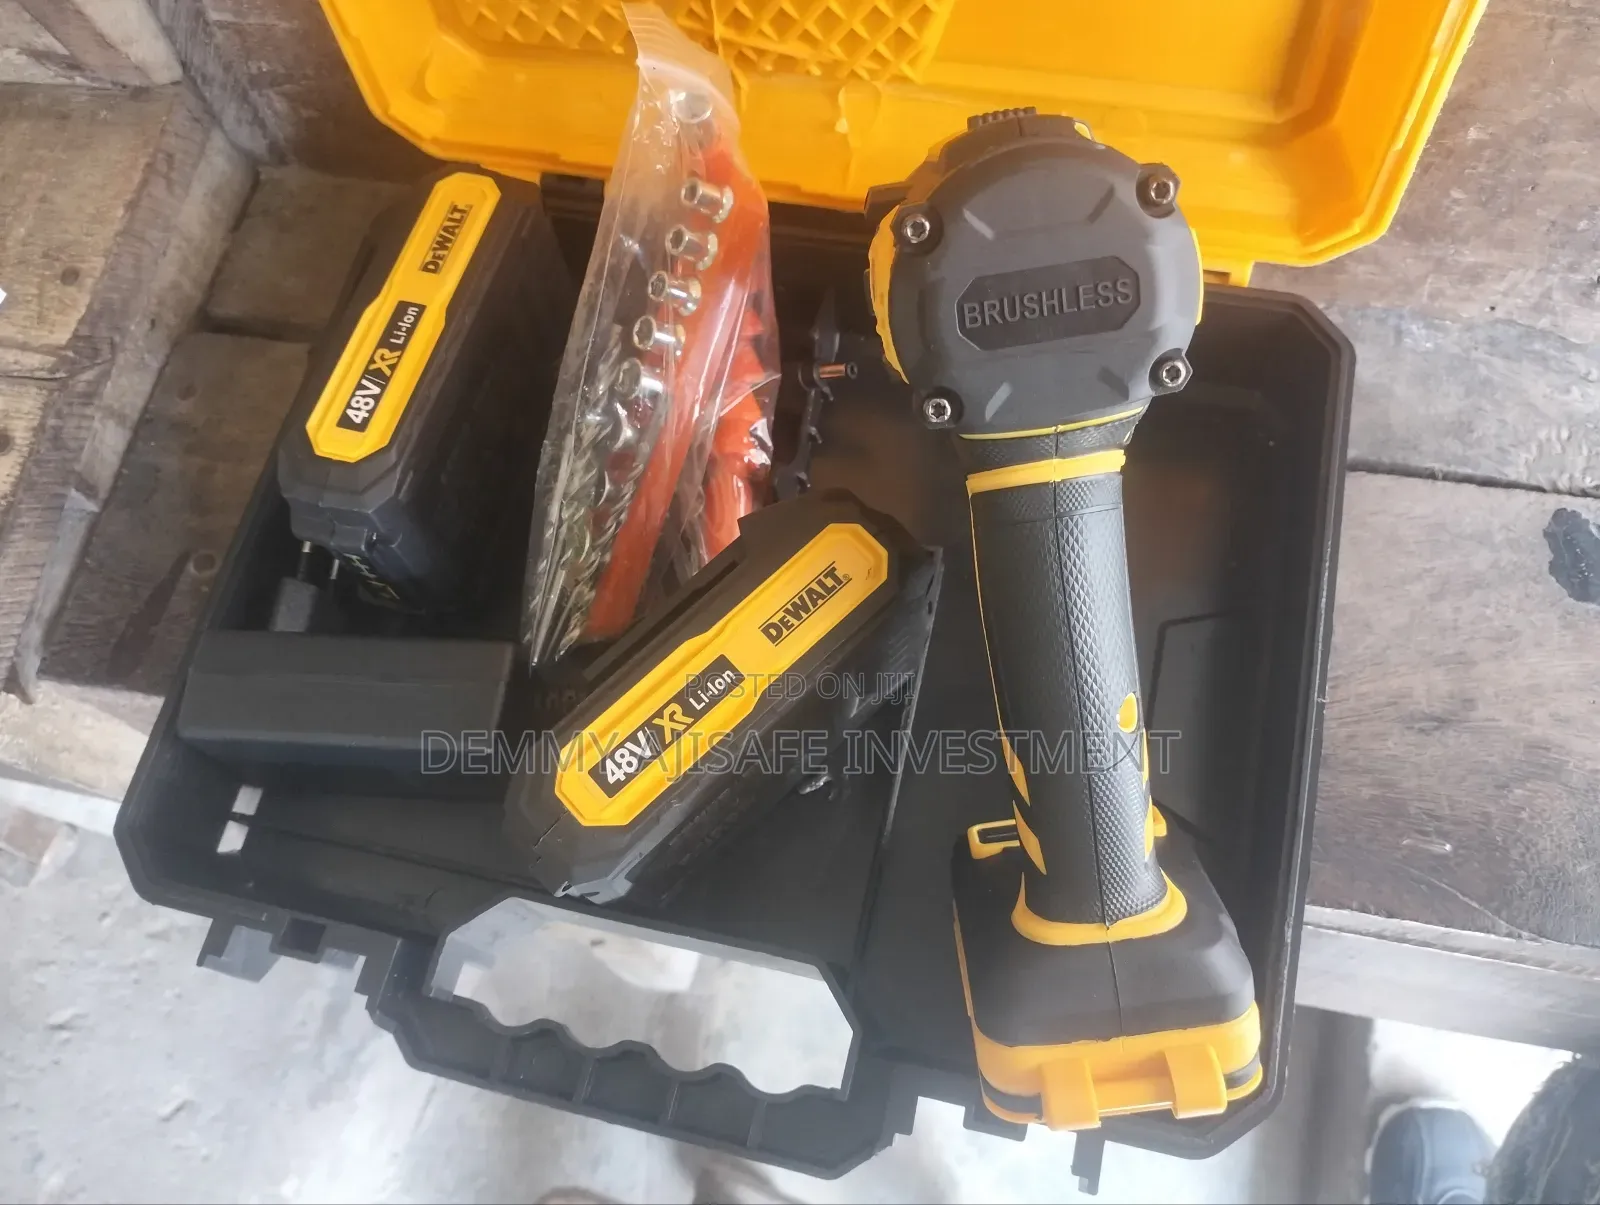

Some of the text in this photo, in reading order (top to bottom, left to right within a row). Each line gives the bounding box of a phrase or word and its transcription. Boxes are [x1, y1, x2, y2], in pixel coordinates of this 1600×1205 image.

[961, 278, 1134, 329] BRUSHLESS
[345, 378, 382, 424] 48V
[368, 347, 402, 377] XR
[605, 730, 652, 784] 48V
[651, 702, 695, 745] XR
